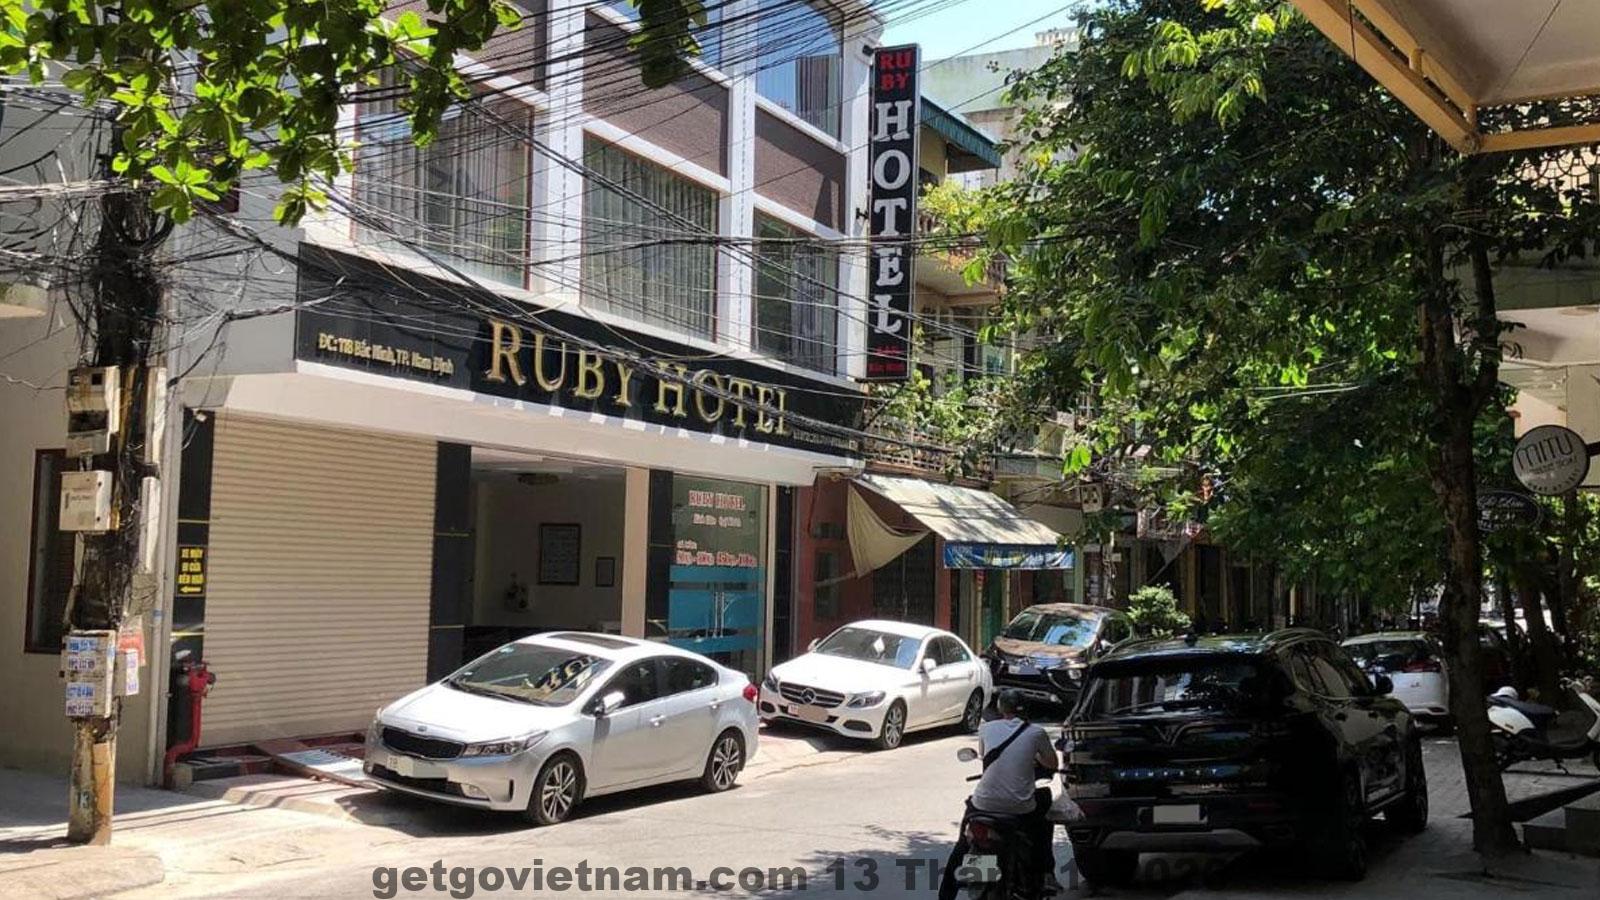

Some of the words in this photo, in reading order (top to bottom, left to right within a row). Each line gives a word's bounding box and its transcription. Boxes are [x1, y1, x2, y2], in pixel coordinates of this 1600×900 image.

[879, 52, 912, 69] RU
[880, 73, 910, 91] BY
[873, 100, 912, 333] HOTEL
[485, 319, 633, 407] RUBY
